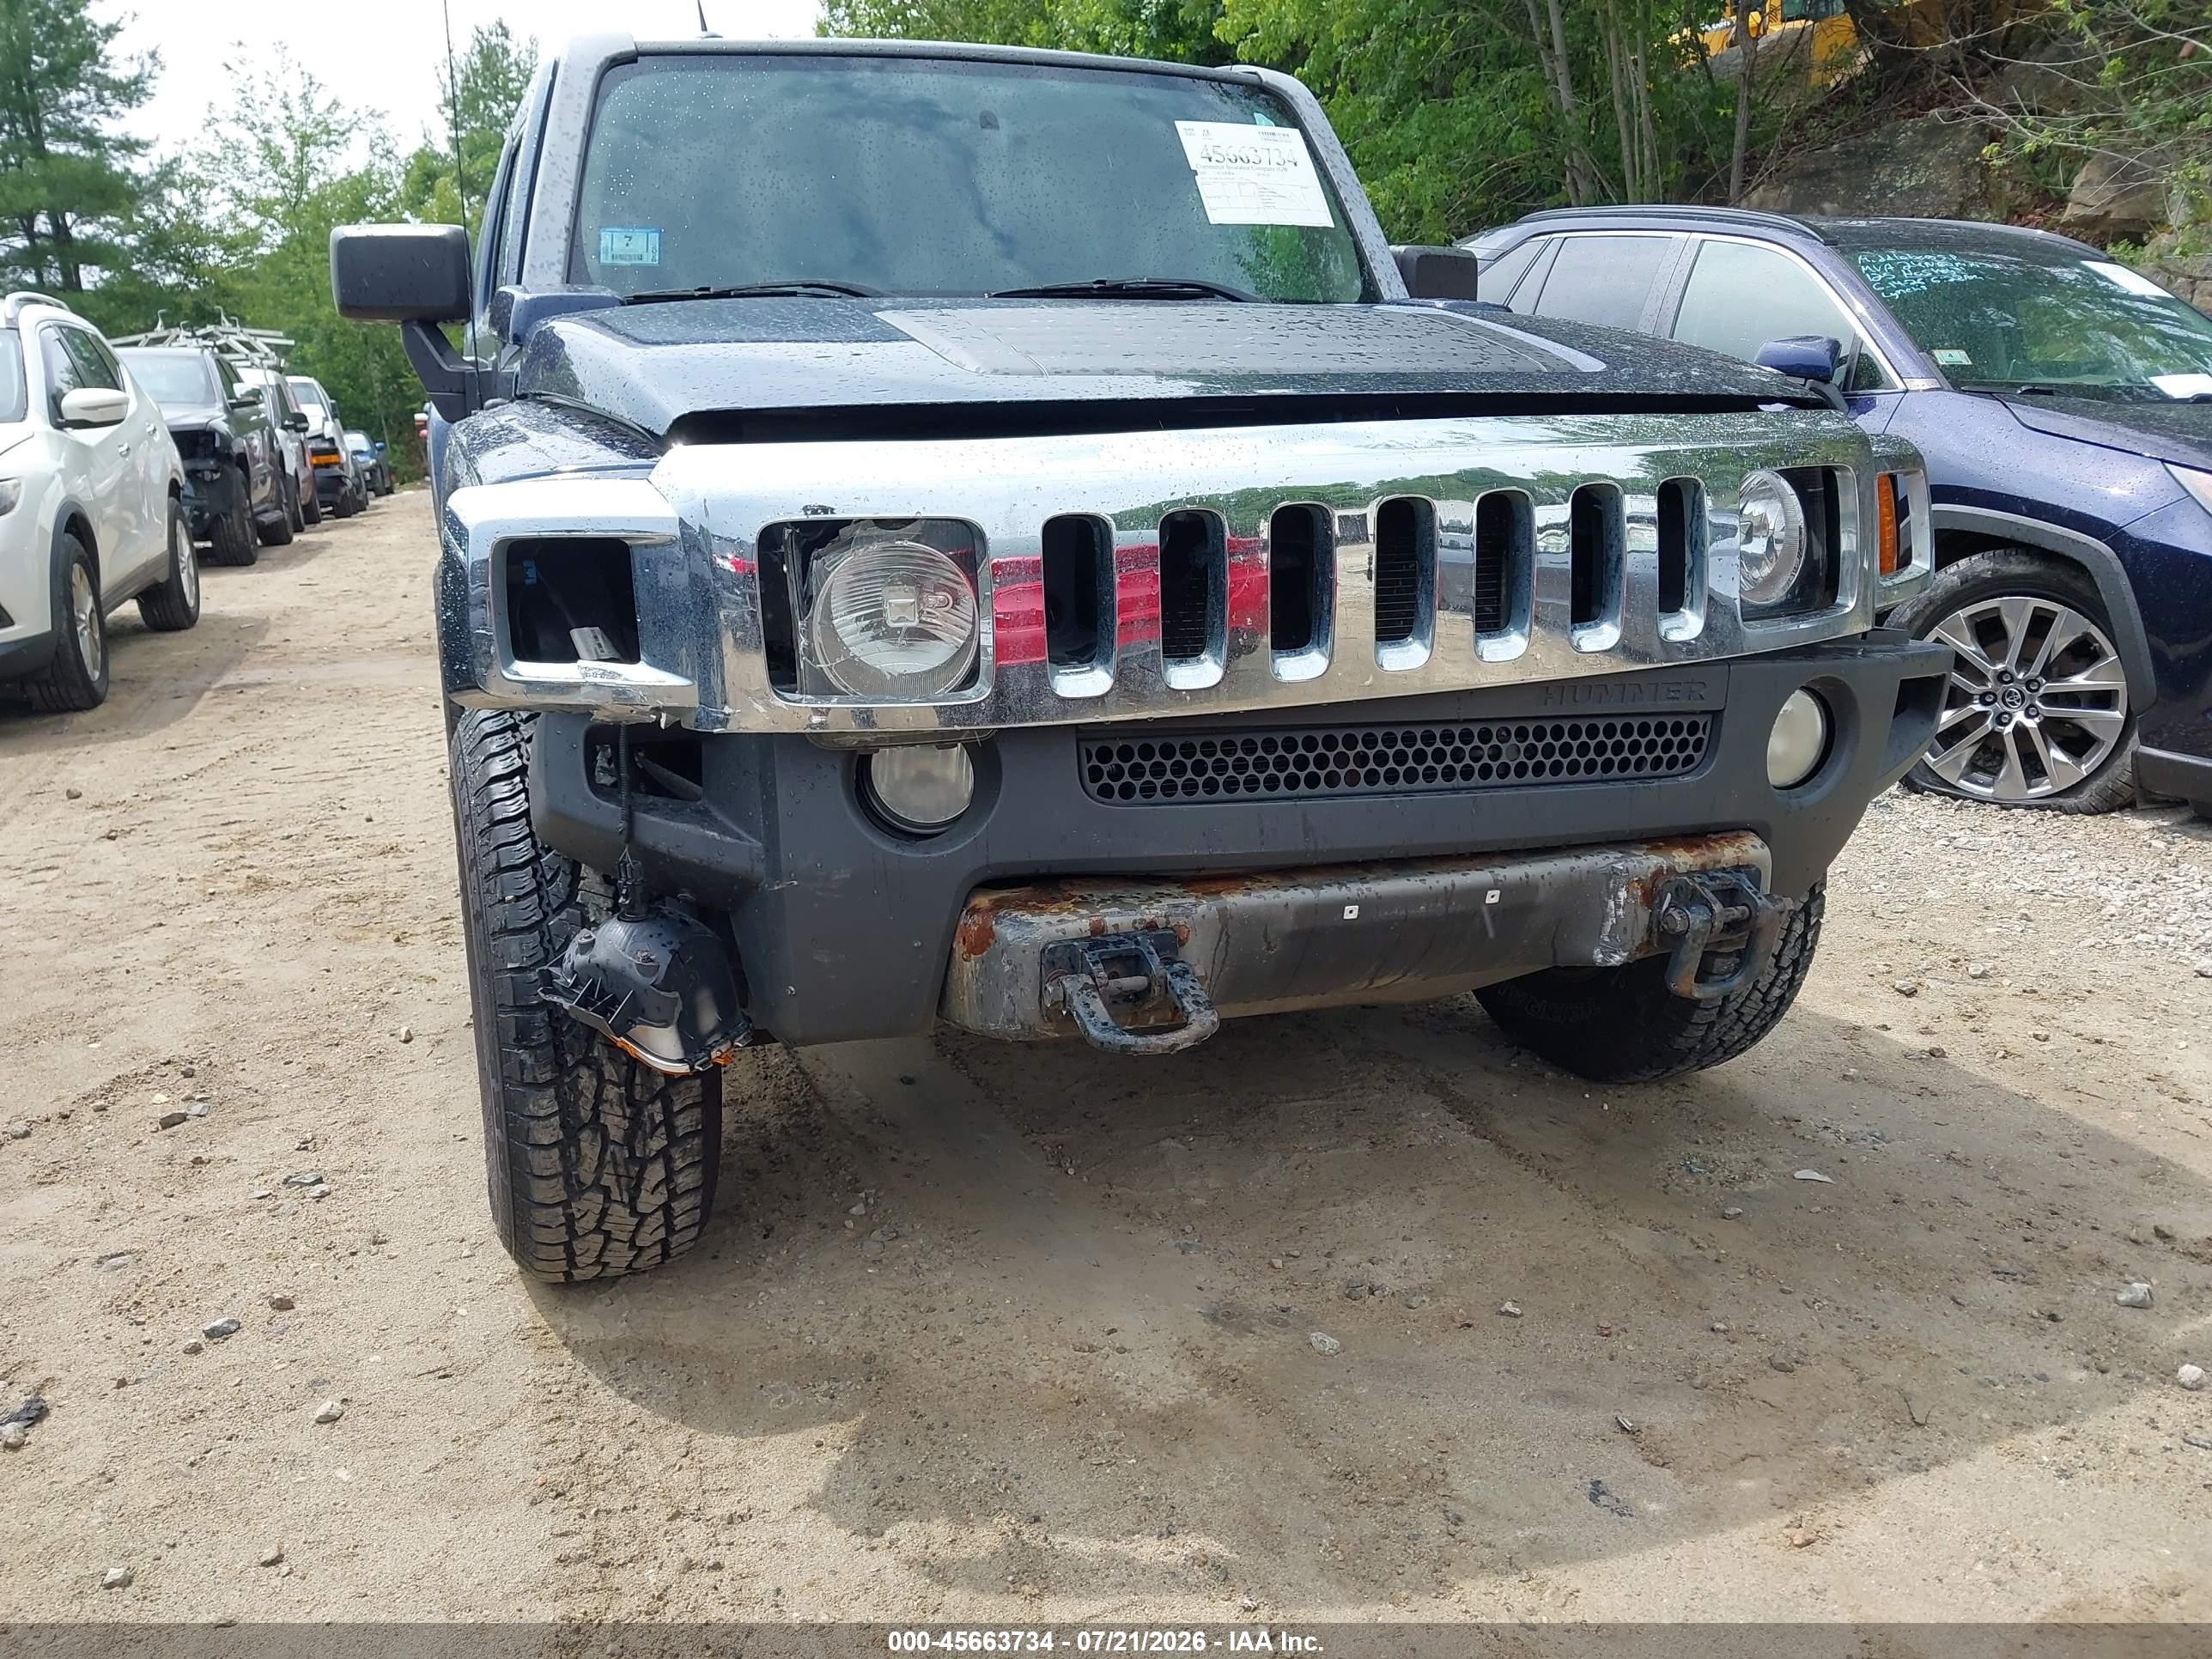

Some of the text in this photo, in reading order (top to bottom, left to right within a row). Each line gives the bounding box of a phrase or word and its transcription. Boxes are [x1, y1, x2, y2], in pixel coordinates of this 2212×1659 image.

[1200, 144, 1298, 167] 45663734
[624, 234, 633, 247] 7
[1538, 680, 1707, 706] HUMMER
